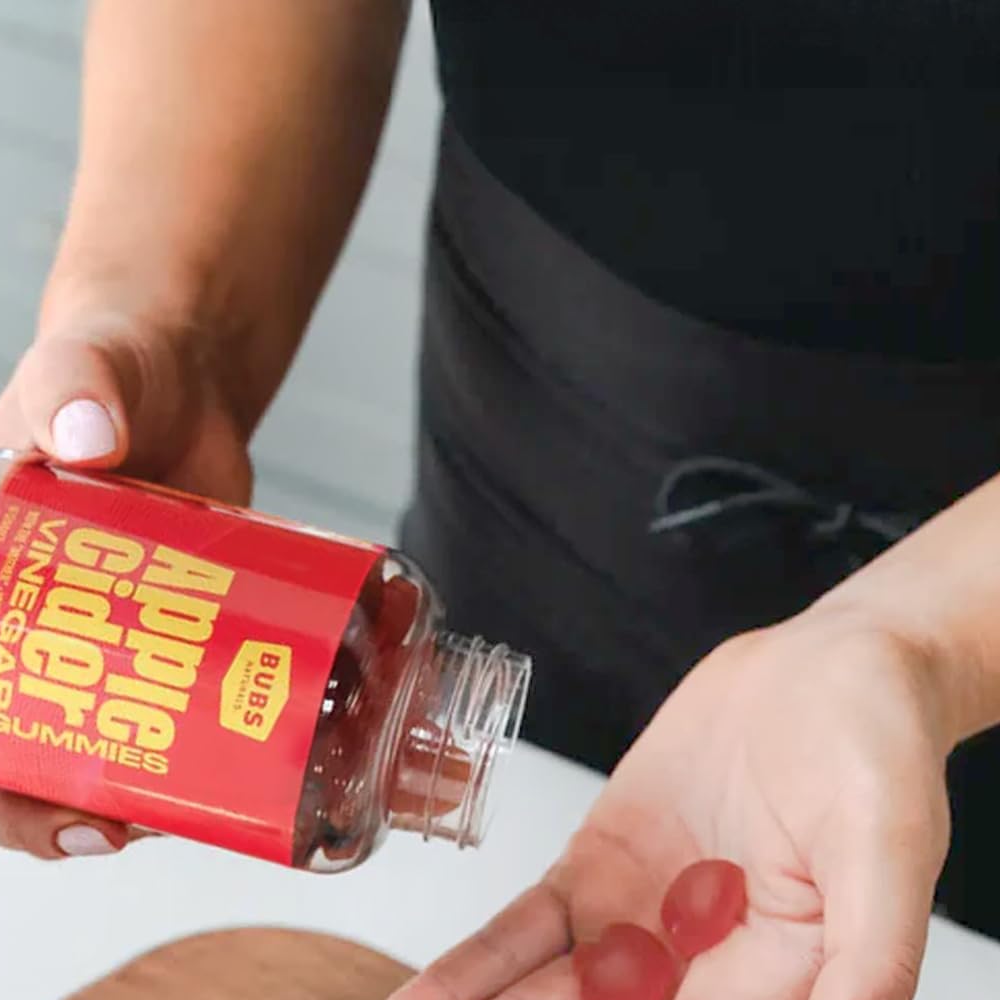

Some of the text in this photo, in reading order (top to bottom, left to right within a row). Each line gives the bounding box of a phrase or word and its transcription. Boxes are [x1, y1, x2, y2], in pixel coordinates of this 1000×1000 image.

[19, 528, 145, 727] Cider
[97, 545, 235, 751] Apple
[243, 651, 281, 727] BUBS
